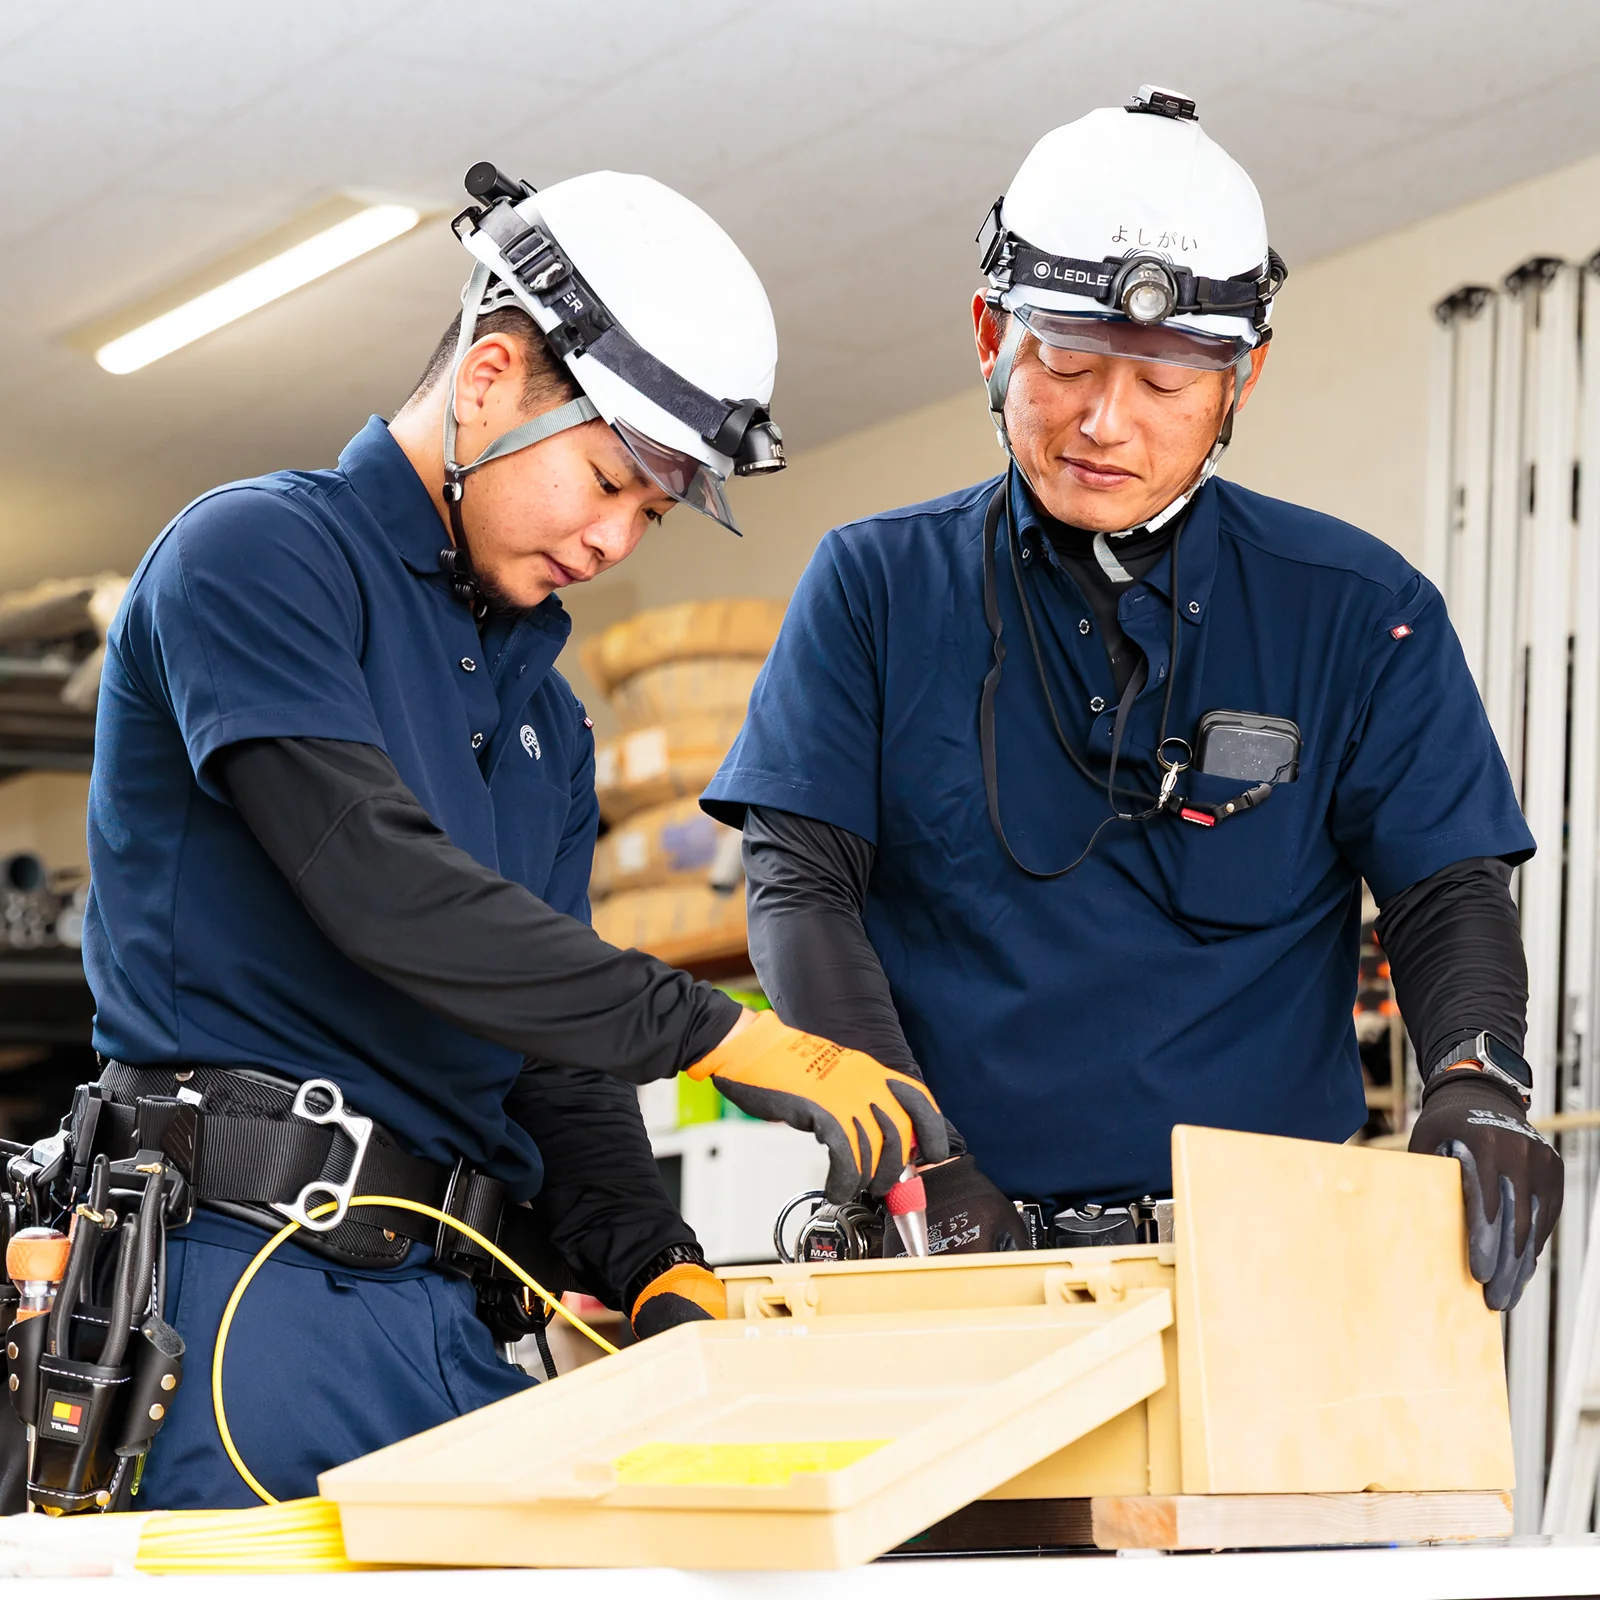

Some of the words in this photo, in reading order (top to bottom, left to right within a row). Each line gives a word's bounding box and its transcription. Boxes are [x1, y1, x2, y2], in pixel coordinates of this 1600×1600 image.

[1111, 224, 1198, 252] よしがい
[1054, 266, 1114, 287] LEDLE
[810, 1248, 838, 1259] MAG
